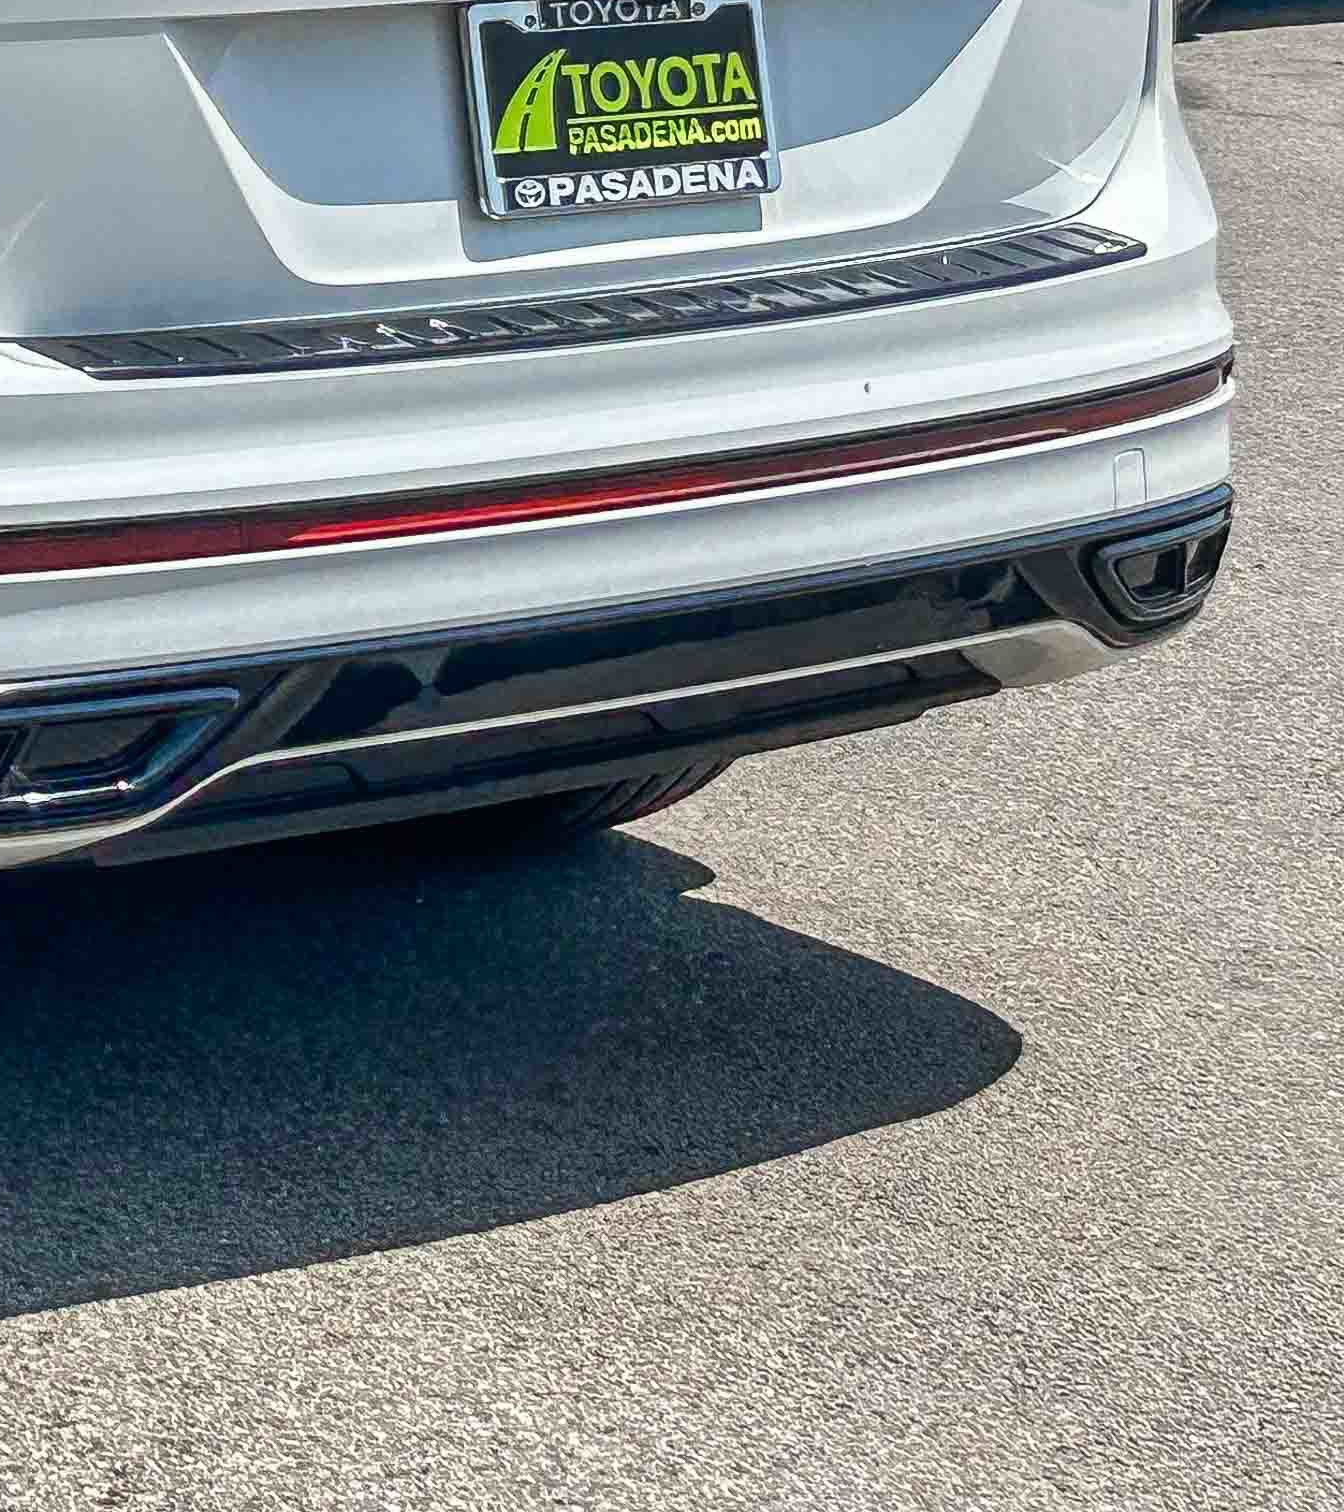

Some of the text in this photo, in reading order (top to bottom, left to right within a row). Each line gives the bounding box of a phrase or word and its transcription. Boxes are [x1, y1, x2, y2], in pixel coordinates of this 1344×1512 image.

[561, 50, 759, 114] TOYOTA
[567, 116, 763, 156] PASADENA.com
[548, 159, 767, 206] PASADENA
